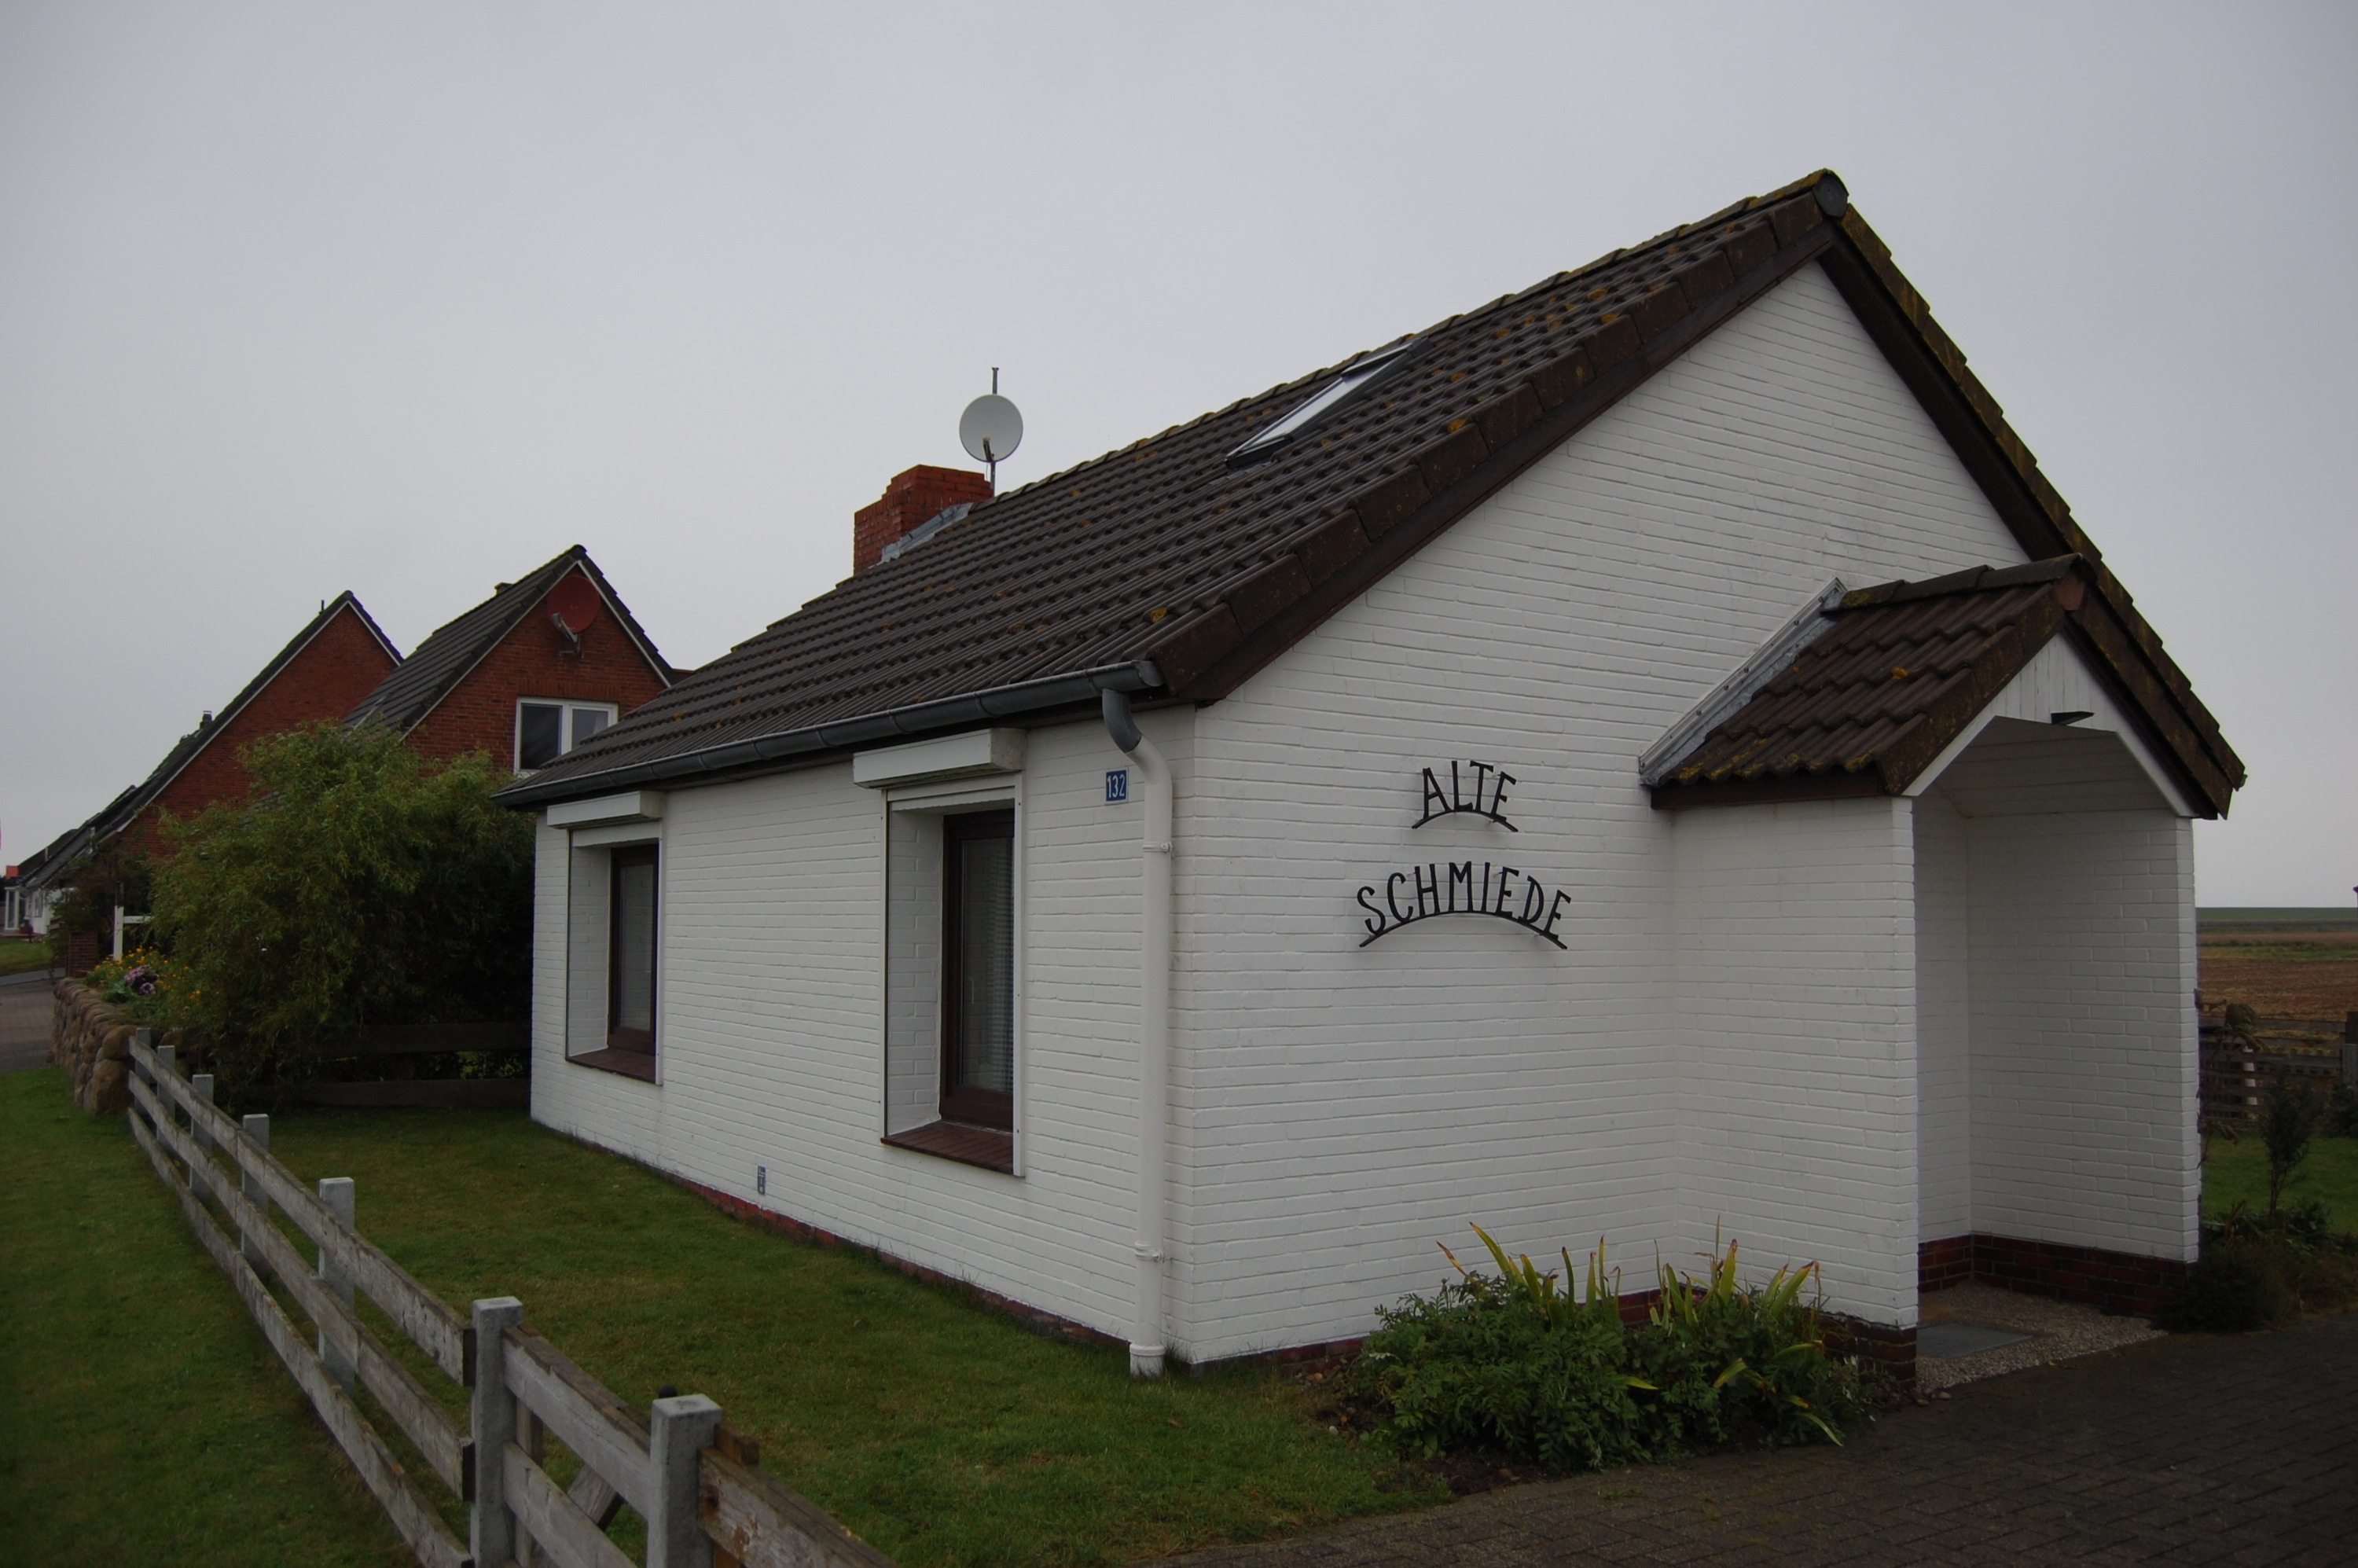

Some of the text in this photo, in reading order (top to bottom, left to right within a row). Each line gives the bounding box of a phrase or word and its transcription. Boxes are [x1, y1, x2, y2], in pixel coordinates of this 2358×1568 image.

[1107, 773, 1125, 799] 132
[1423, 760, 1517, 823] ALTE
[1357, 861, 1572, 942] SCHMIEDE
